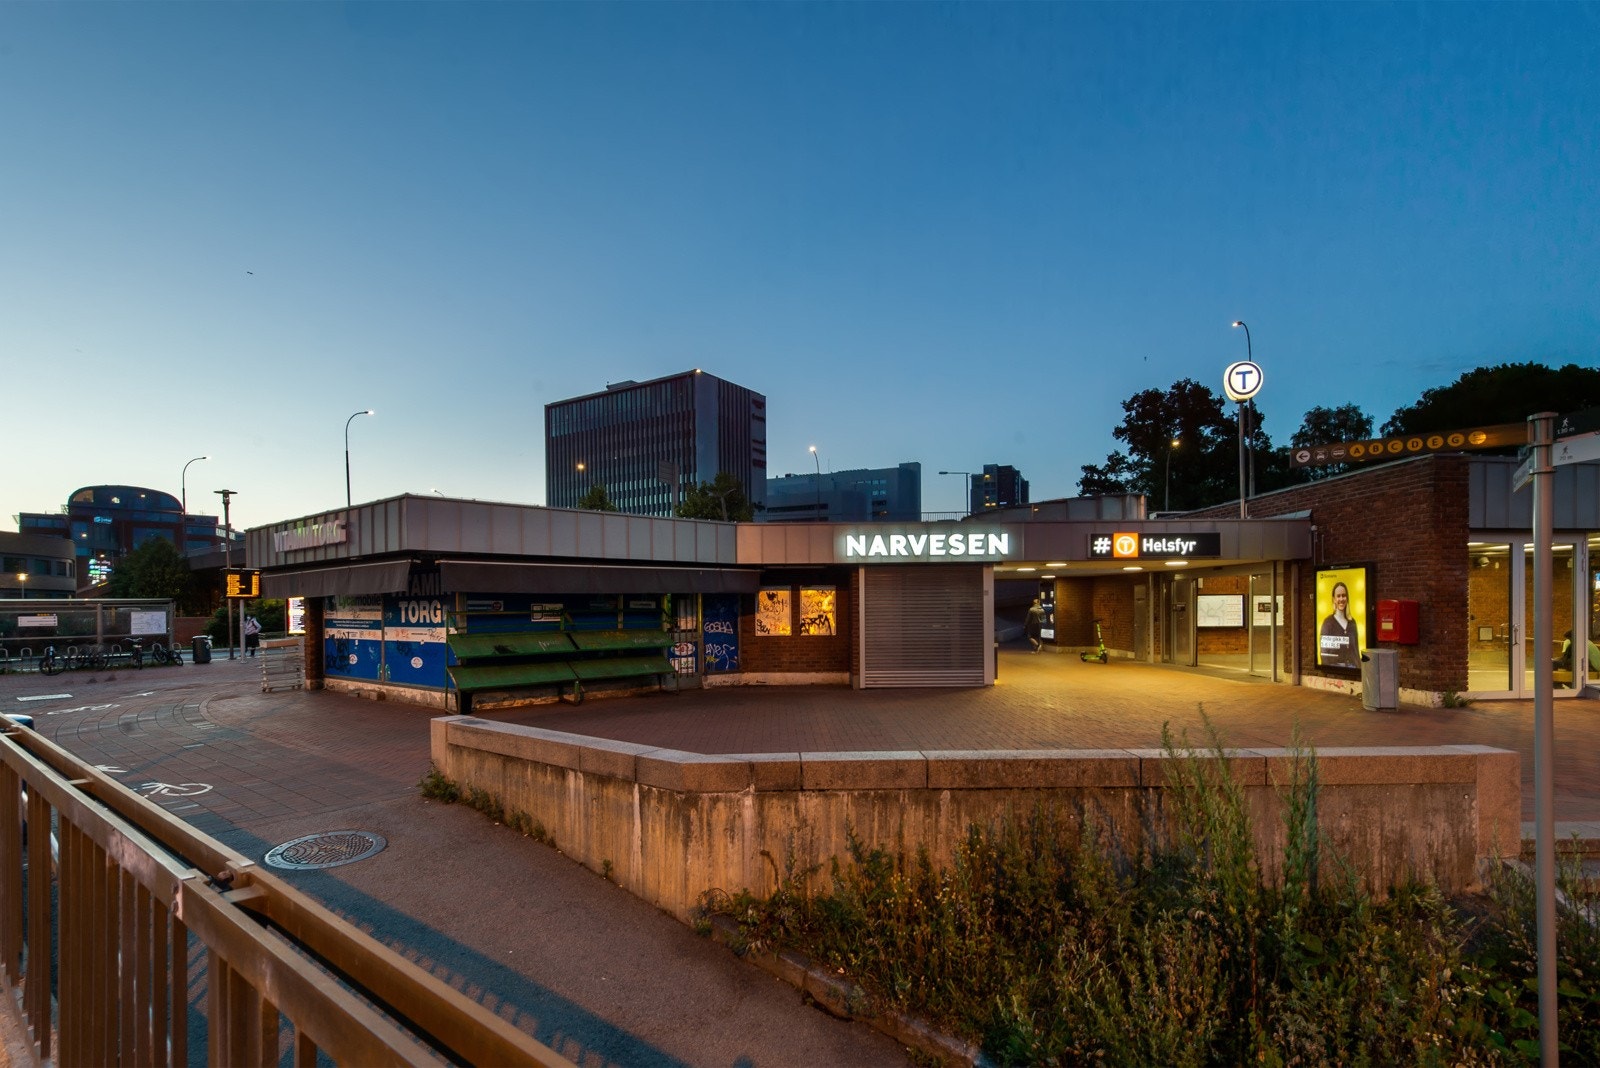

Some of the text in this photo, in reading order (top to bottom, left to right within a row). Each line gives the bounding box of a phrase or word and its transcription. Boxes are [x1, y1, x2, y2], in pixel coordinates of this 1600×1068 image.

[1235, 370, 1253, 390] T
[846, 533, 1009, 557] NARVESEN
[1142, 537, 1197, 555] Helsfyr
[398, 599, 442, 624] TORG
